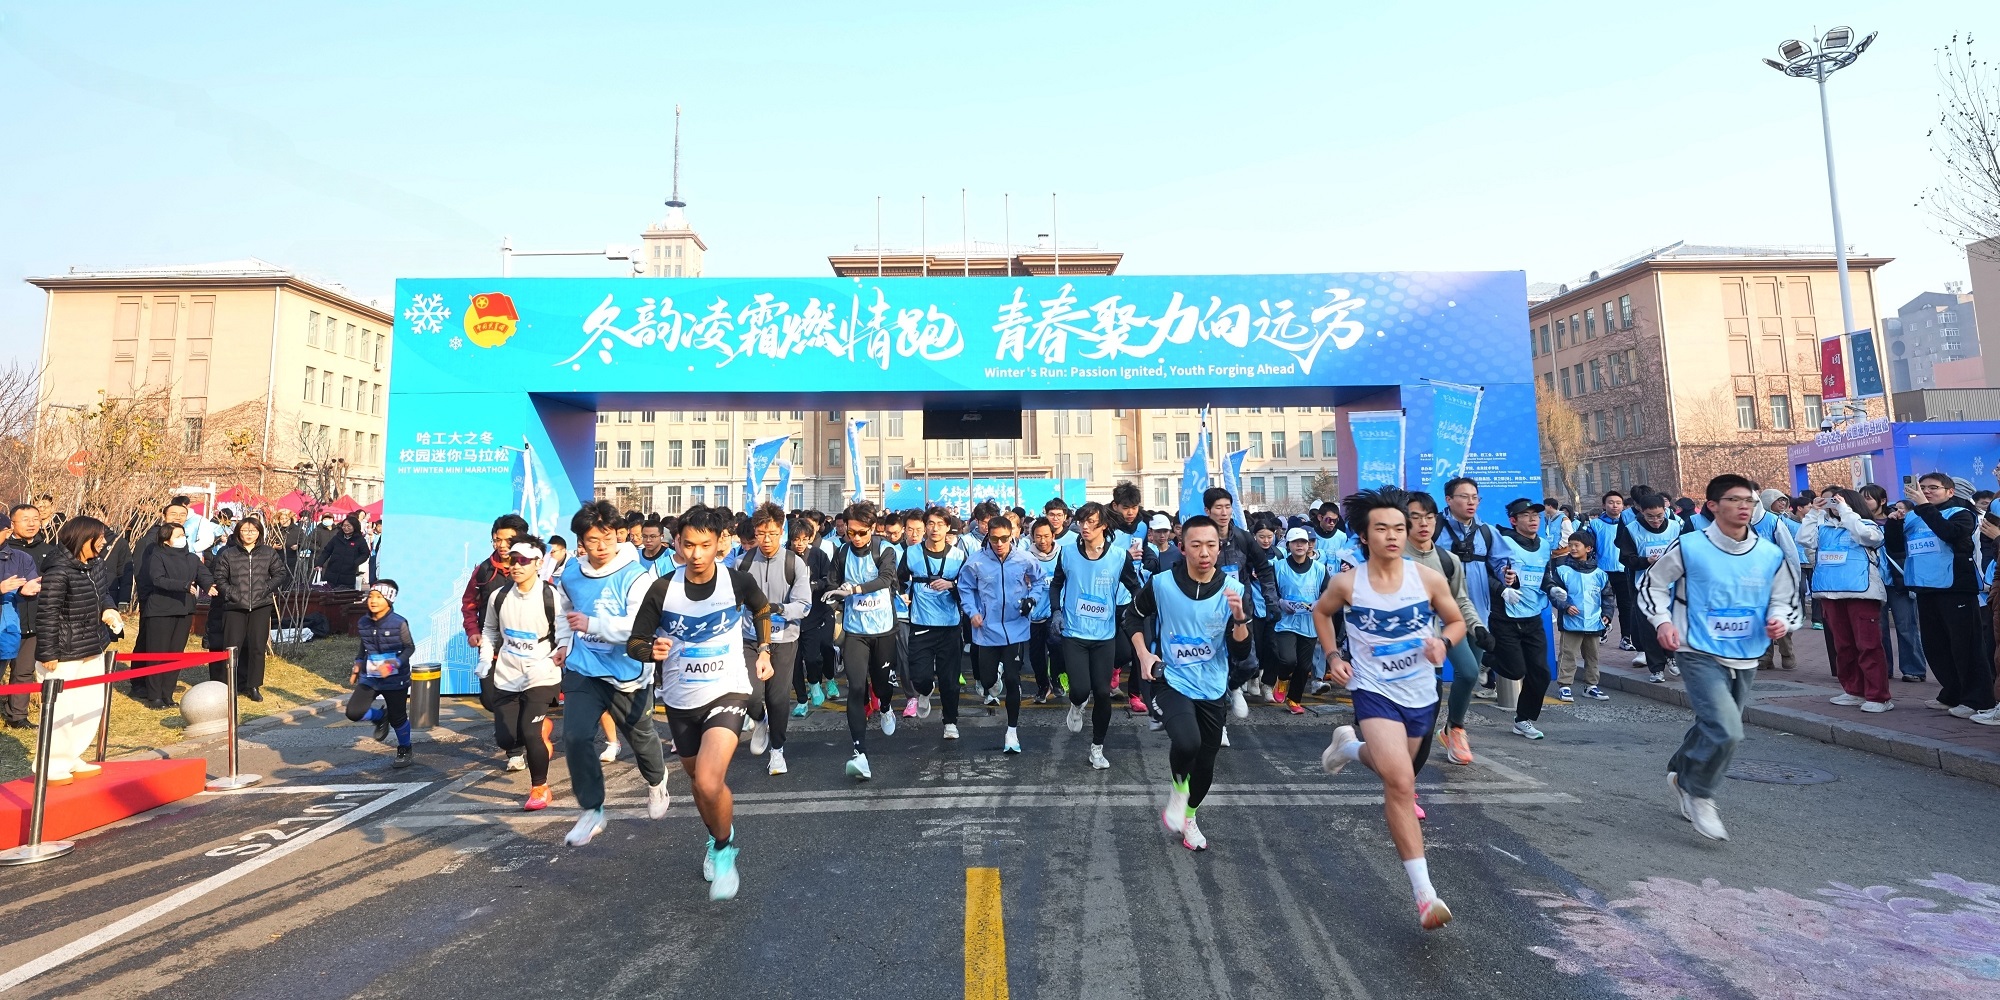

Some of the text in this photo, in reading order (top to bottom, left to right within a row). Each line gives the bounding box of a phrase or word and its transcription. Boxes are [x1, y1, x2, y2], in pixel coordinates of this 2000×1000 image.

[553, 283, 1366, 375] 冬韵凌霜燃情跑 青春聚力向远方
[984, 363, 1295, 378] Winter's Run: Passion Ignited, Youth Forging Ahead
[416, 432, 494, 445] 哈工大之冬
[399, 448, 509, 462] 校园迷你马拉松
[398, 466, 411, 474] HIT
[413, 466, 443, 474] WINTER
[1909, 541, 1935, 550] B1548
[1080, 604, 1105, 613] A0098
[667, 612, 730, 637] 哈工大
[1359, 606, 1425, 631] 哈工大
[1714, 620, 1750, 631] AA017
[1177, 646, 1211, 658] AA003
[685, 660, 724, 673] AA002
[1382, 653, 1418, 672] AA007
